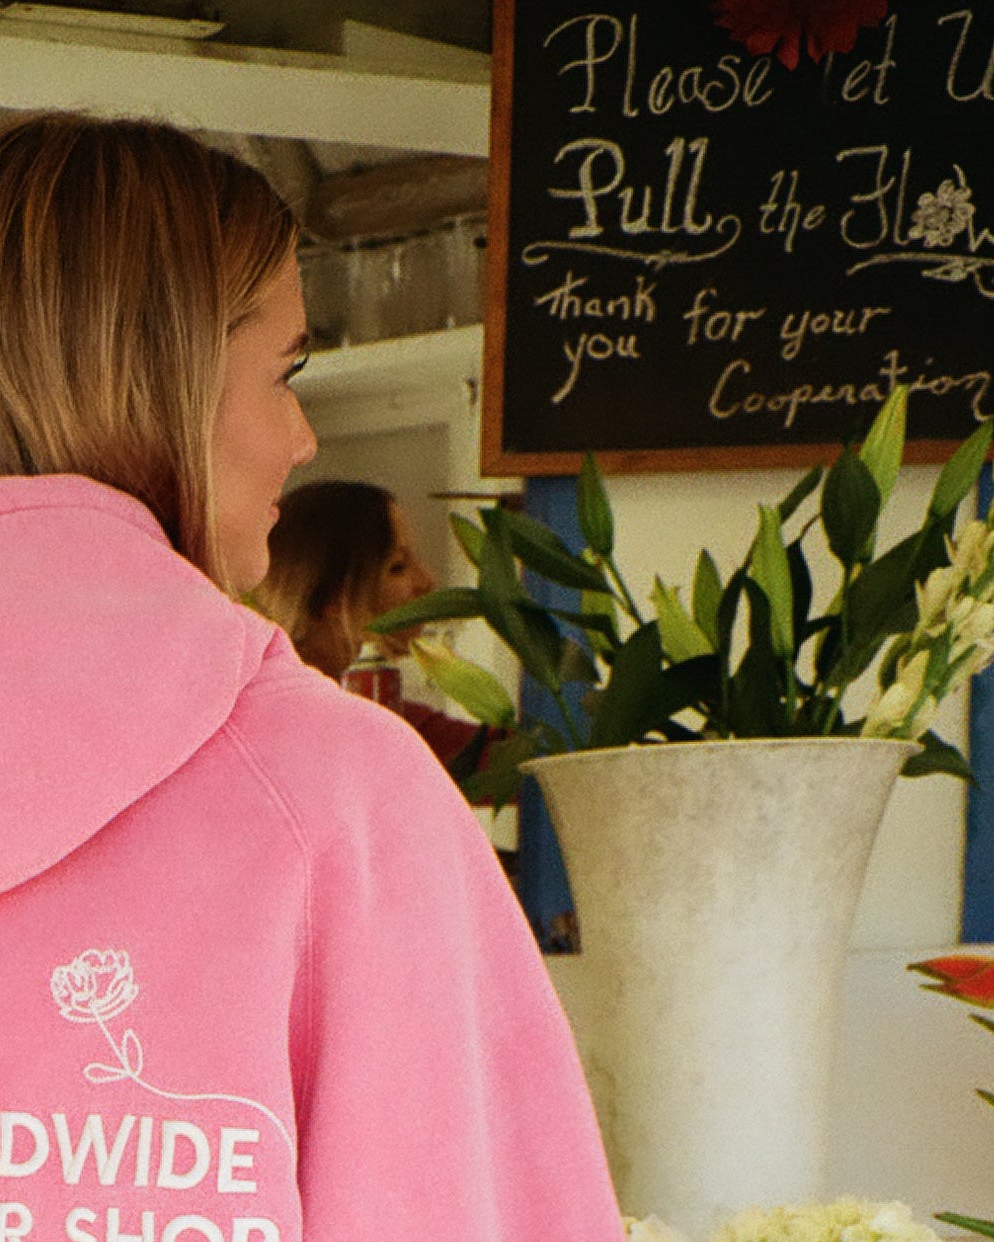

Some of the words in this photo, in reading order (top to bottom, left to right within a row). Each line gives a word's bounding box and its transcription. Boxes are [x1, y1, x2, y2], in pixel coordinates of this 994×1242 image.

[543, 13, 773, 117] Please
[821, 13, 898, 105] et
[546, 136, 713, 239] Pull
[758, 169, 827, 252] the
[552, 332, 641, 404] you
[682, 288, 766, 345] for
[779, 306, 891, 360] your
